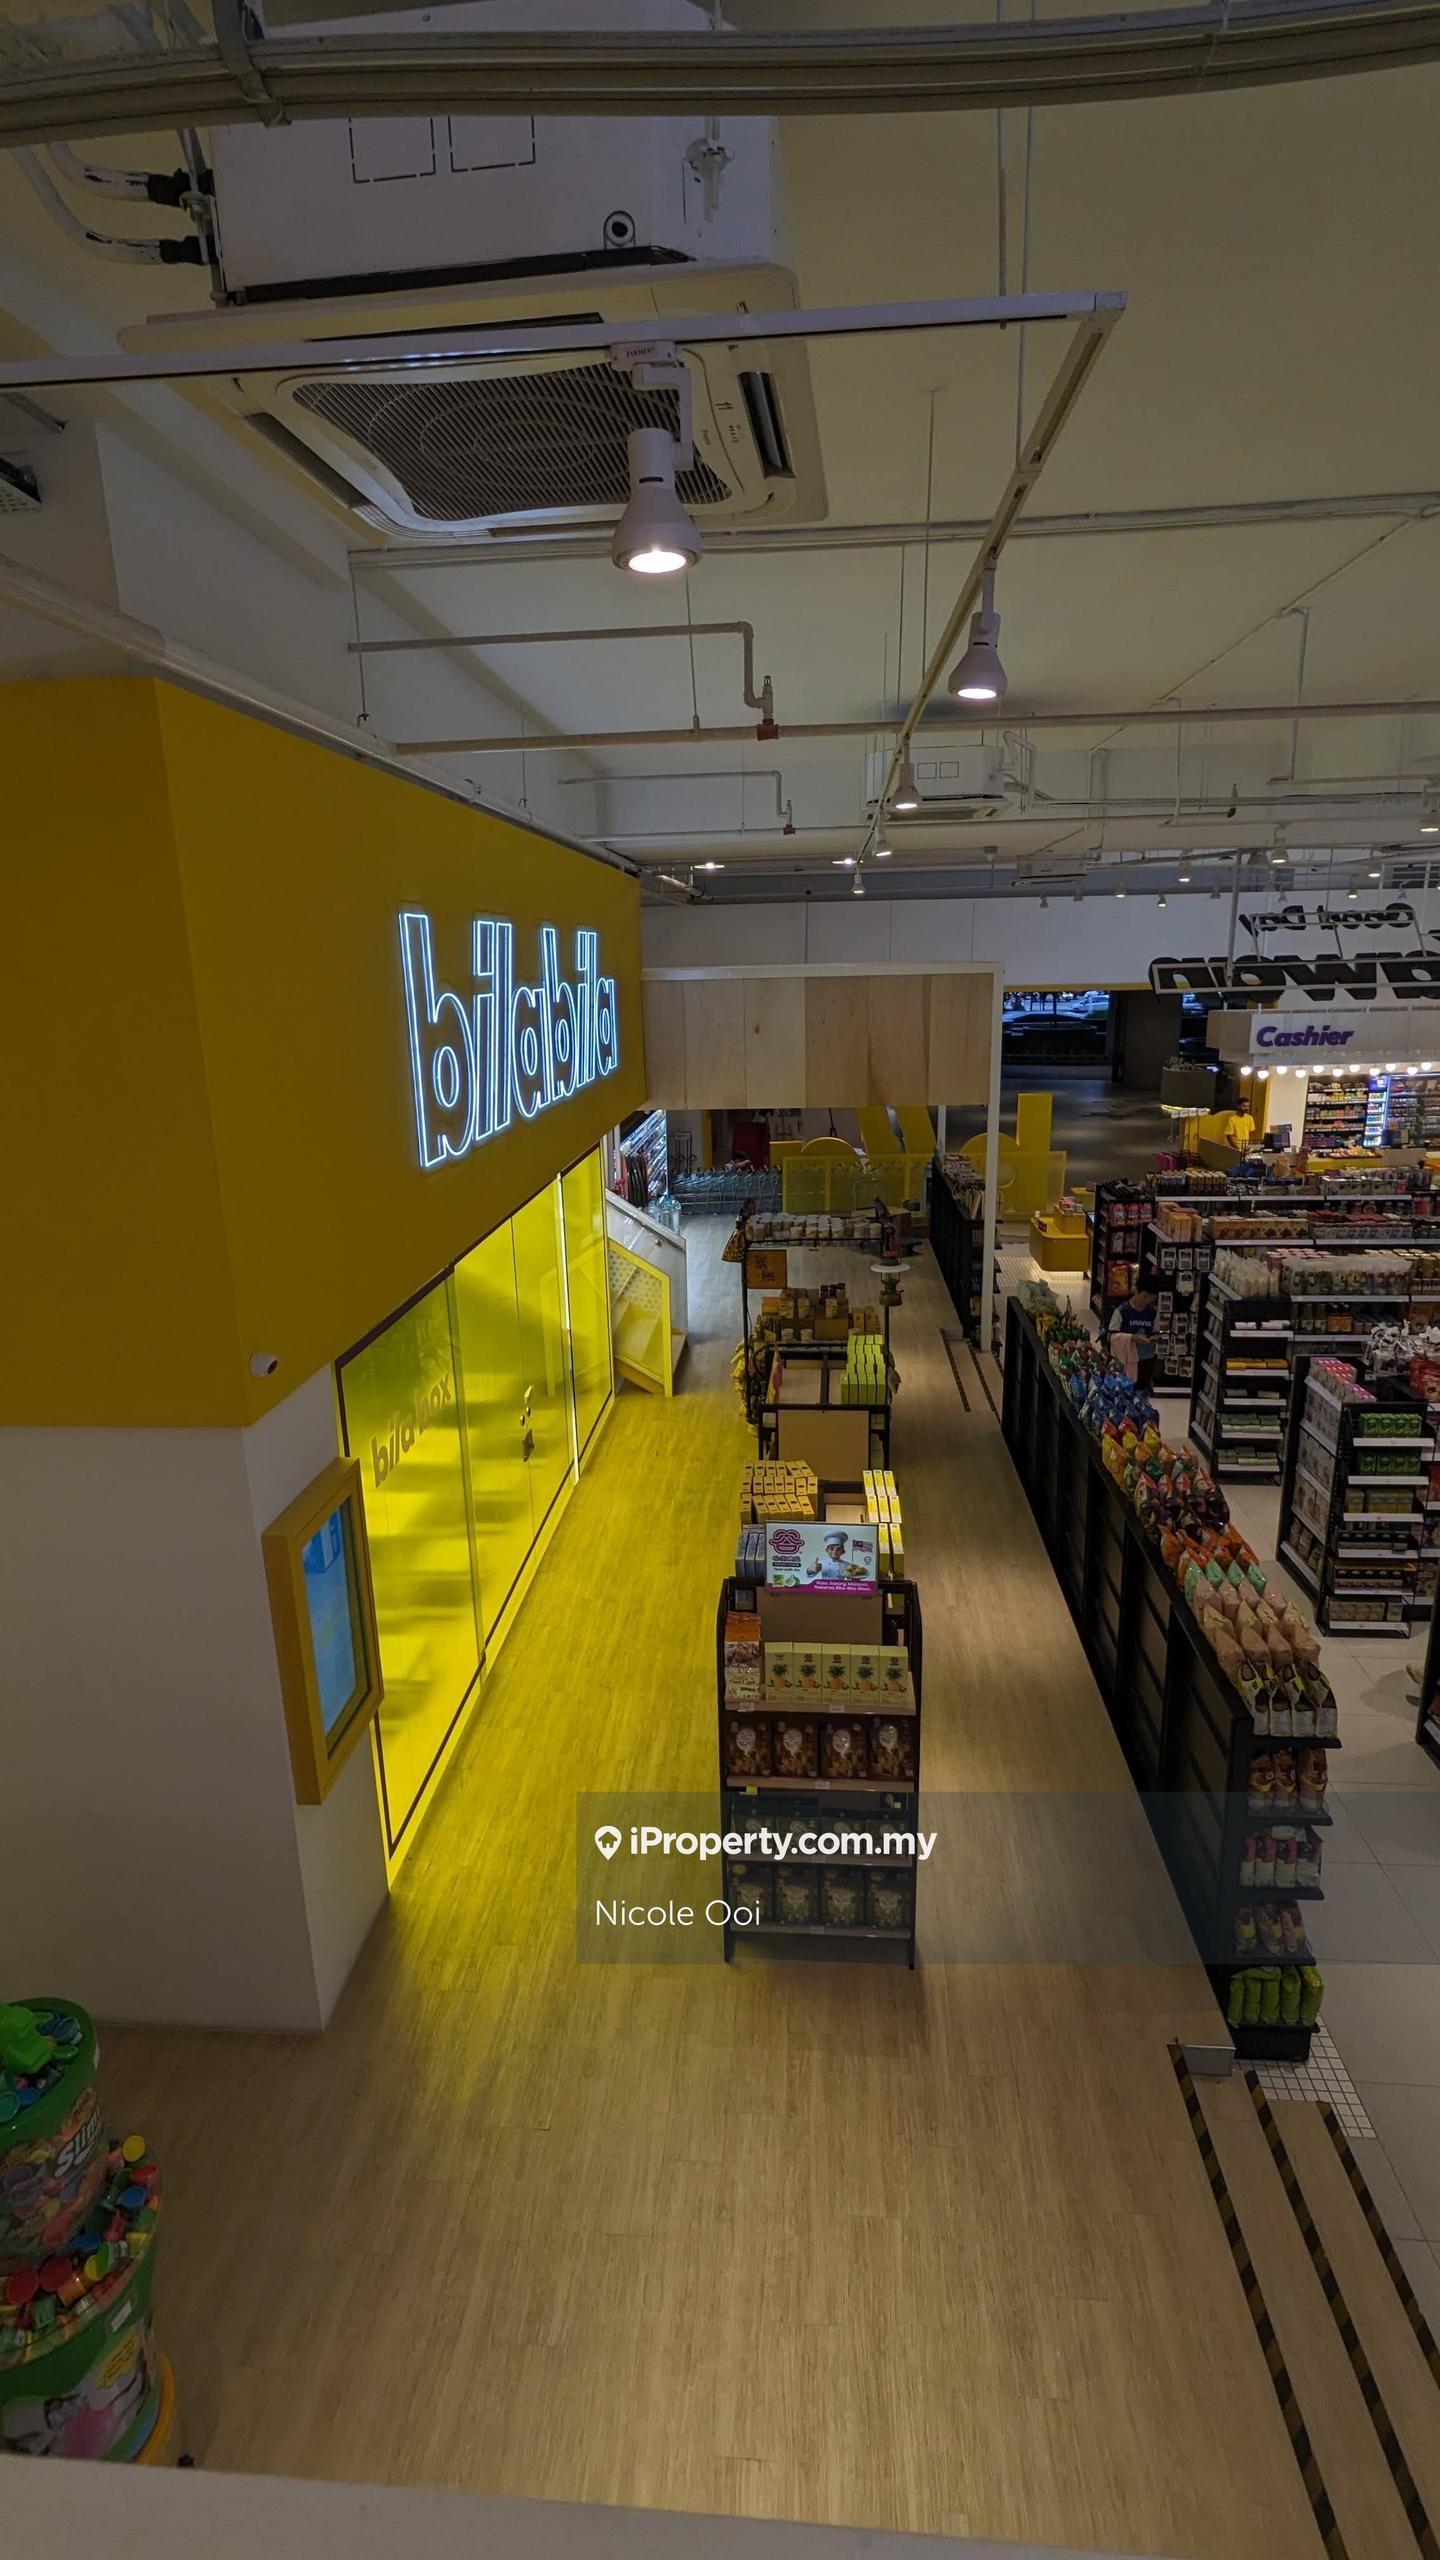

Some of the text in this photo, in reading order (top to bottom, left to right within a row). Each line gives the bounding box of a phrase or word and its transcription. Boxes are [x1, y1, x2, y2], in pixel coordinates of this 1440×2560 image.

[398, 912, 618, 1168] bilabila
[1256, 1024, 1355, 1048] Cashier
[370, 1373, 452, 1489] bila box
